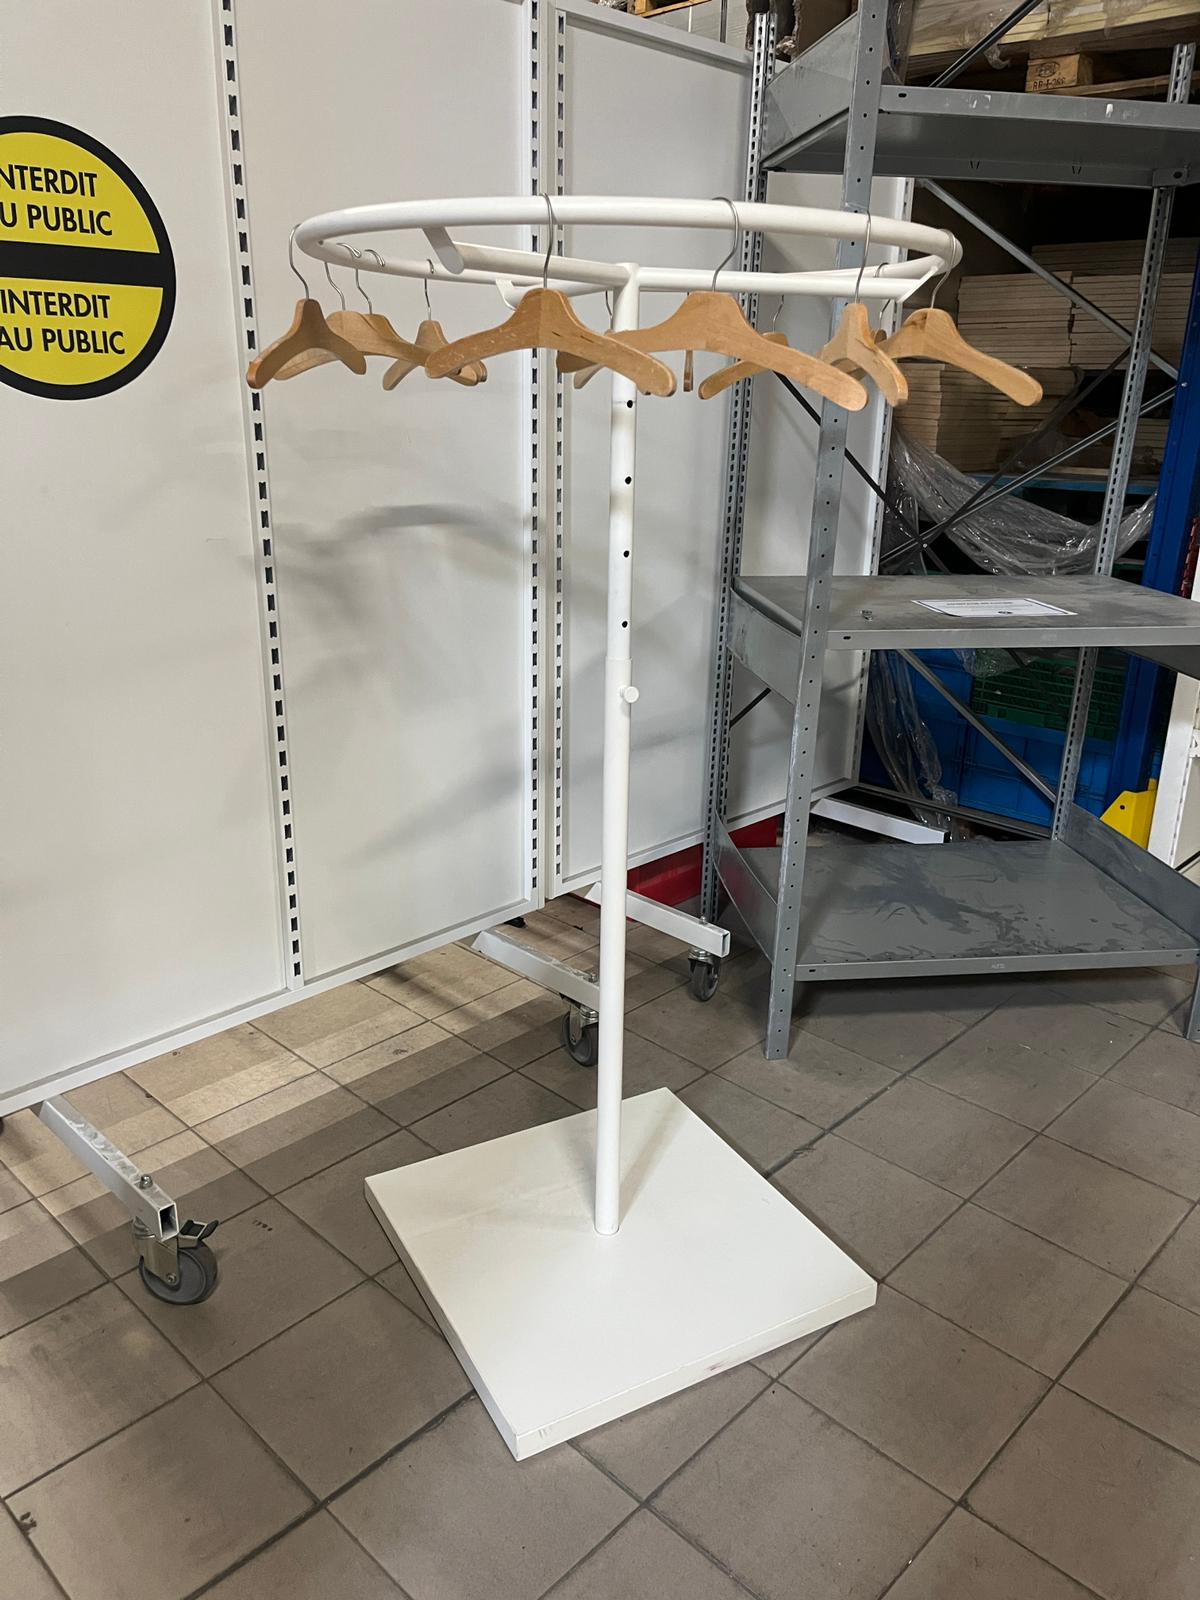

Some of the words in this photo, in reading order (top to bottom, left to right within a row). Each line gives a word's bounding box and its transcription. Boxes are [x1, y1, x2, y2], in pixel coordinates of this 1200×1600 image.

[0, 164, 97, 197] NTERDIT
[27, 204, 113, 236] PUBLIC
[0, 289, 110, 318] INTERDIT
[0, 326, 33, 352] AU
[42, 328, 125, 355] PUBLIC
